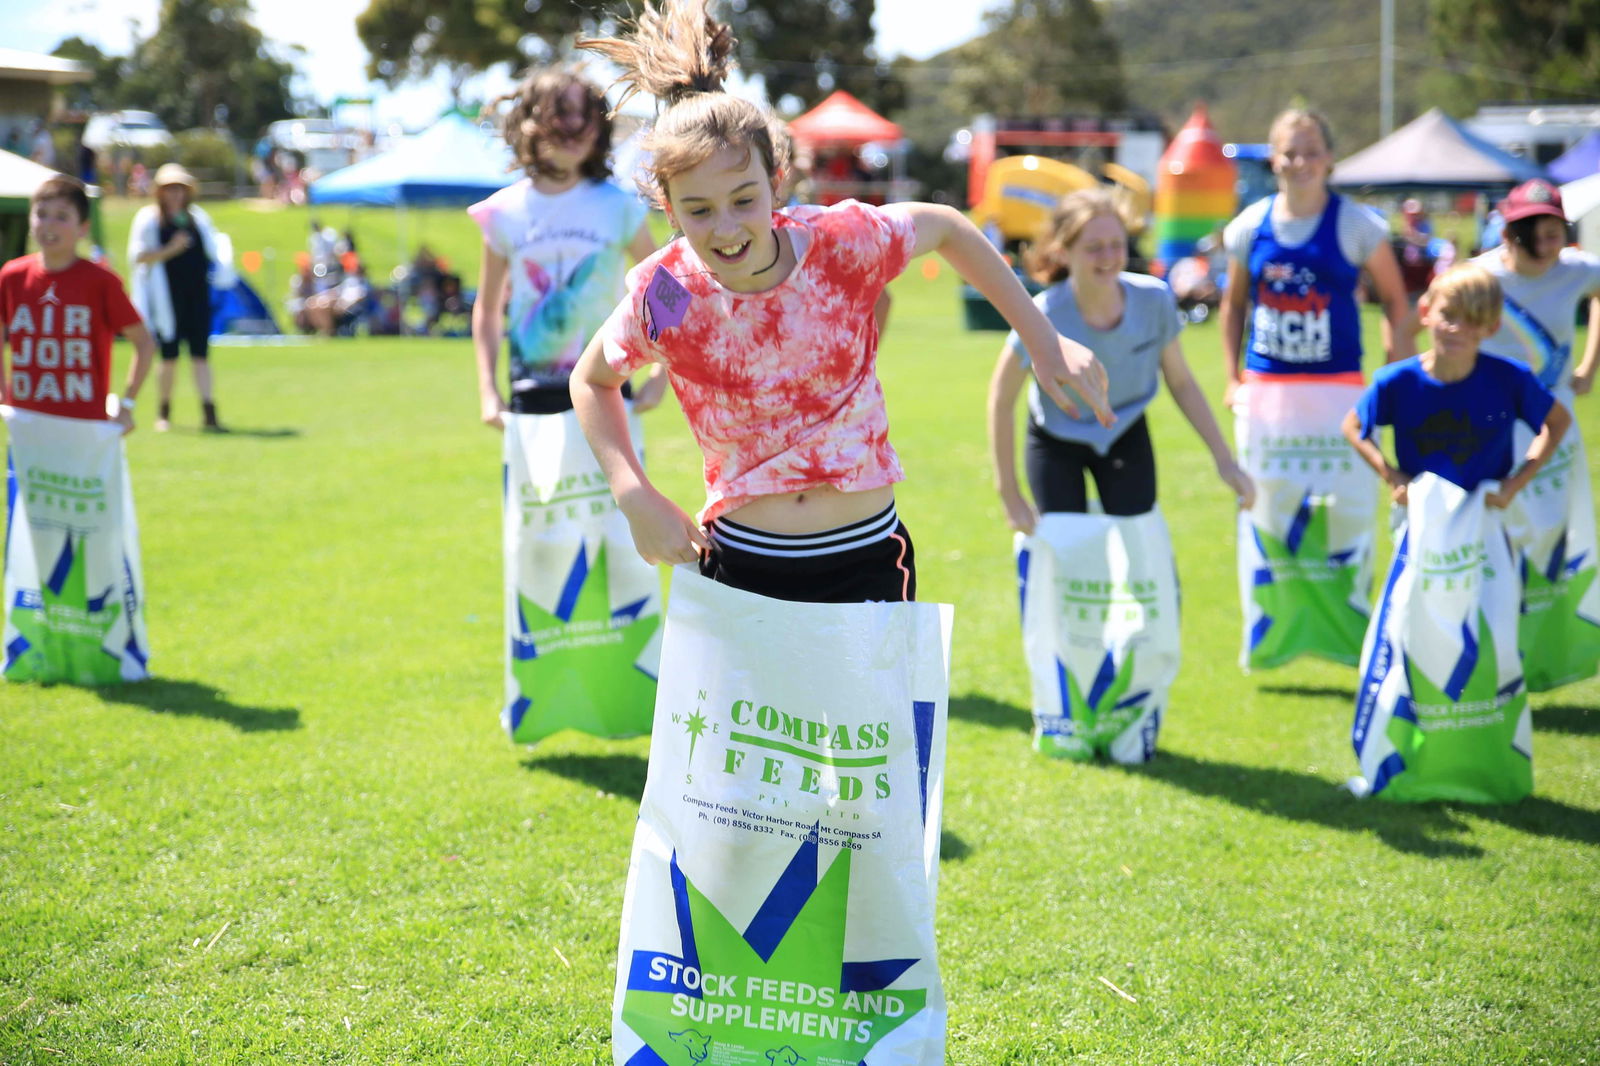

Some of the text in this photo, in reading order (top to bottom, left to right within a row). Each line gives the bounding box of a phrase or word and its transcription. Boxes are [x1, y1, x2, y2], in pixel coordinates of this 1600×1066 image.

[10, 304, 92, 335] AIR
[12, 336, 92, 369] JOR
[13, 372, 94, 402] DAN
[698, 690, 707, 700] N
[672, 713, 719, 734] W E
[730, 700, 889, 750] COMPASS
[686, 773, 692, 784] S
[722, 748, 891, 801] FEEDS
[682, 794, 714, 809] Compass
[715, 803, 738, 814] Feeds
[742, 808, 764, 821] Victor
[766, 815, 793, 827] Harbor
[821, 826, 831, 834] Mt
[833, 828, 870, 840] Compass
[871, 831, 882, 839] SA
[698, 811, 709, 821] Ph.
[713, 816, 731, 827] (08)
[732, 819, 752, 831] 8556
[753, 824, 774, 834] 8332
[780, 829, 797, 840] Fax.
[819, 836, 840, 846] 8556
[841, 840, 862, 851] 8269
[648, 957, 905, 1018] STOCK FEEDS AND
[670, 993, 873, 1044] SUPPLEMENTS
